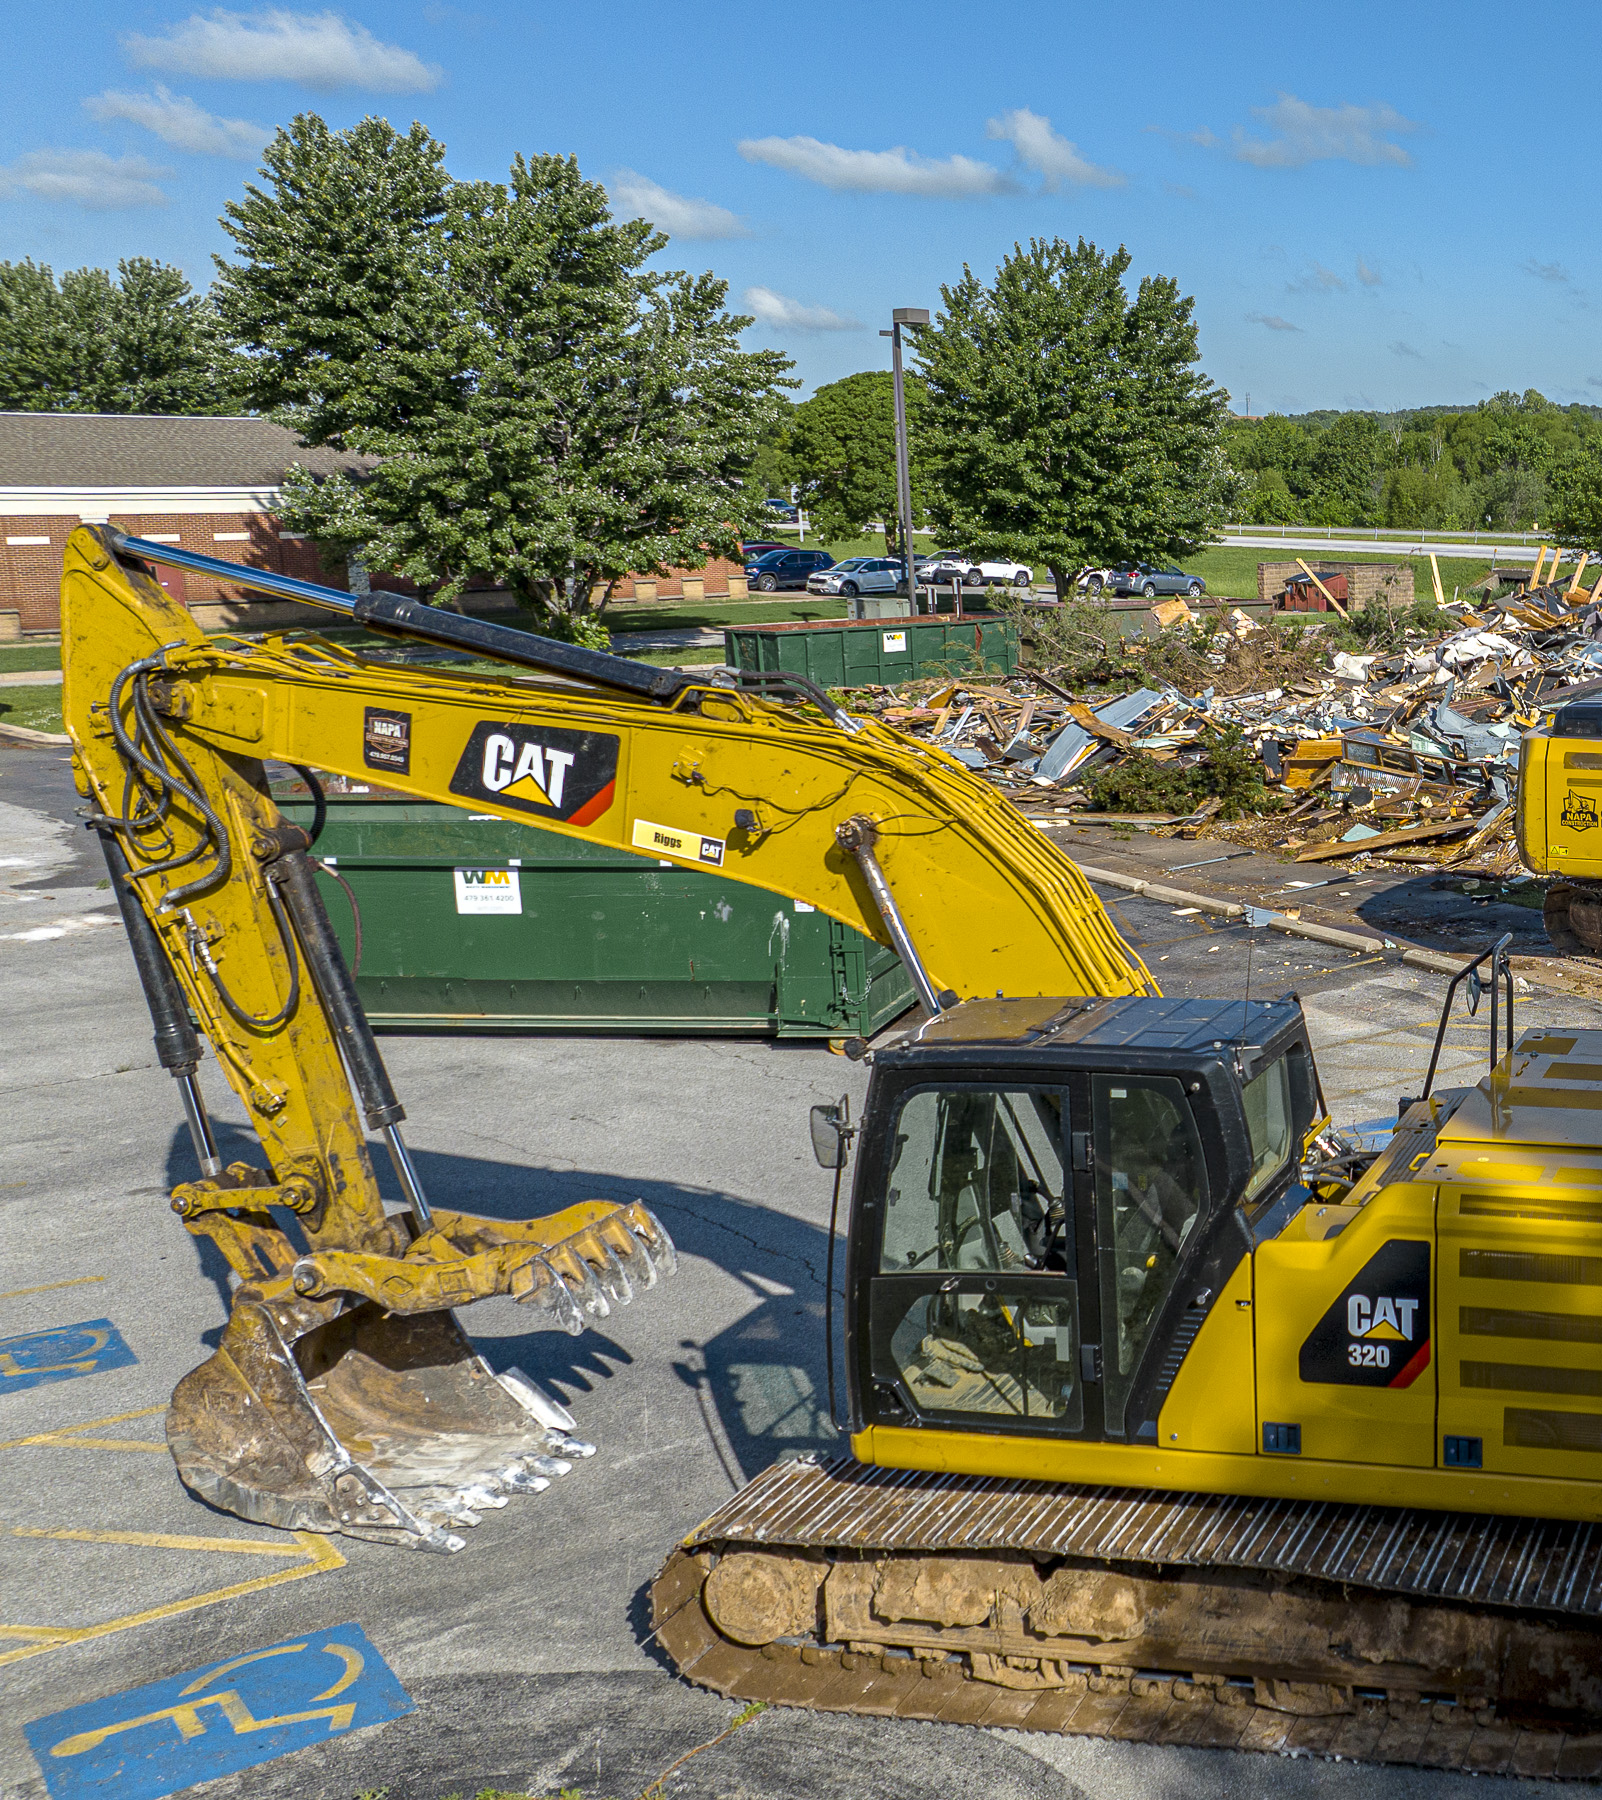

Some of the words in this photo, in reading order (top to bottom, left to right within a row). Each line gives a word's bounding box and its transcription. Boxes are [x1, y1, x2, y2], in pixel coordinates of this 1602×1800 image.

[373, 720, 401, 738] NAPA
[482, 734, 576, 808] CAT
[1566, 812, 1592, 822] NAPA
[653, 832, 682, 848] Riggs
[701, 843, 721, 858] CAT
[462, 870, 510, 884] WM
[1348, 1294, 1418, 1341] CAT
[1348, 1343, 1390, 1368] 320
